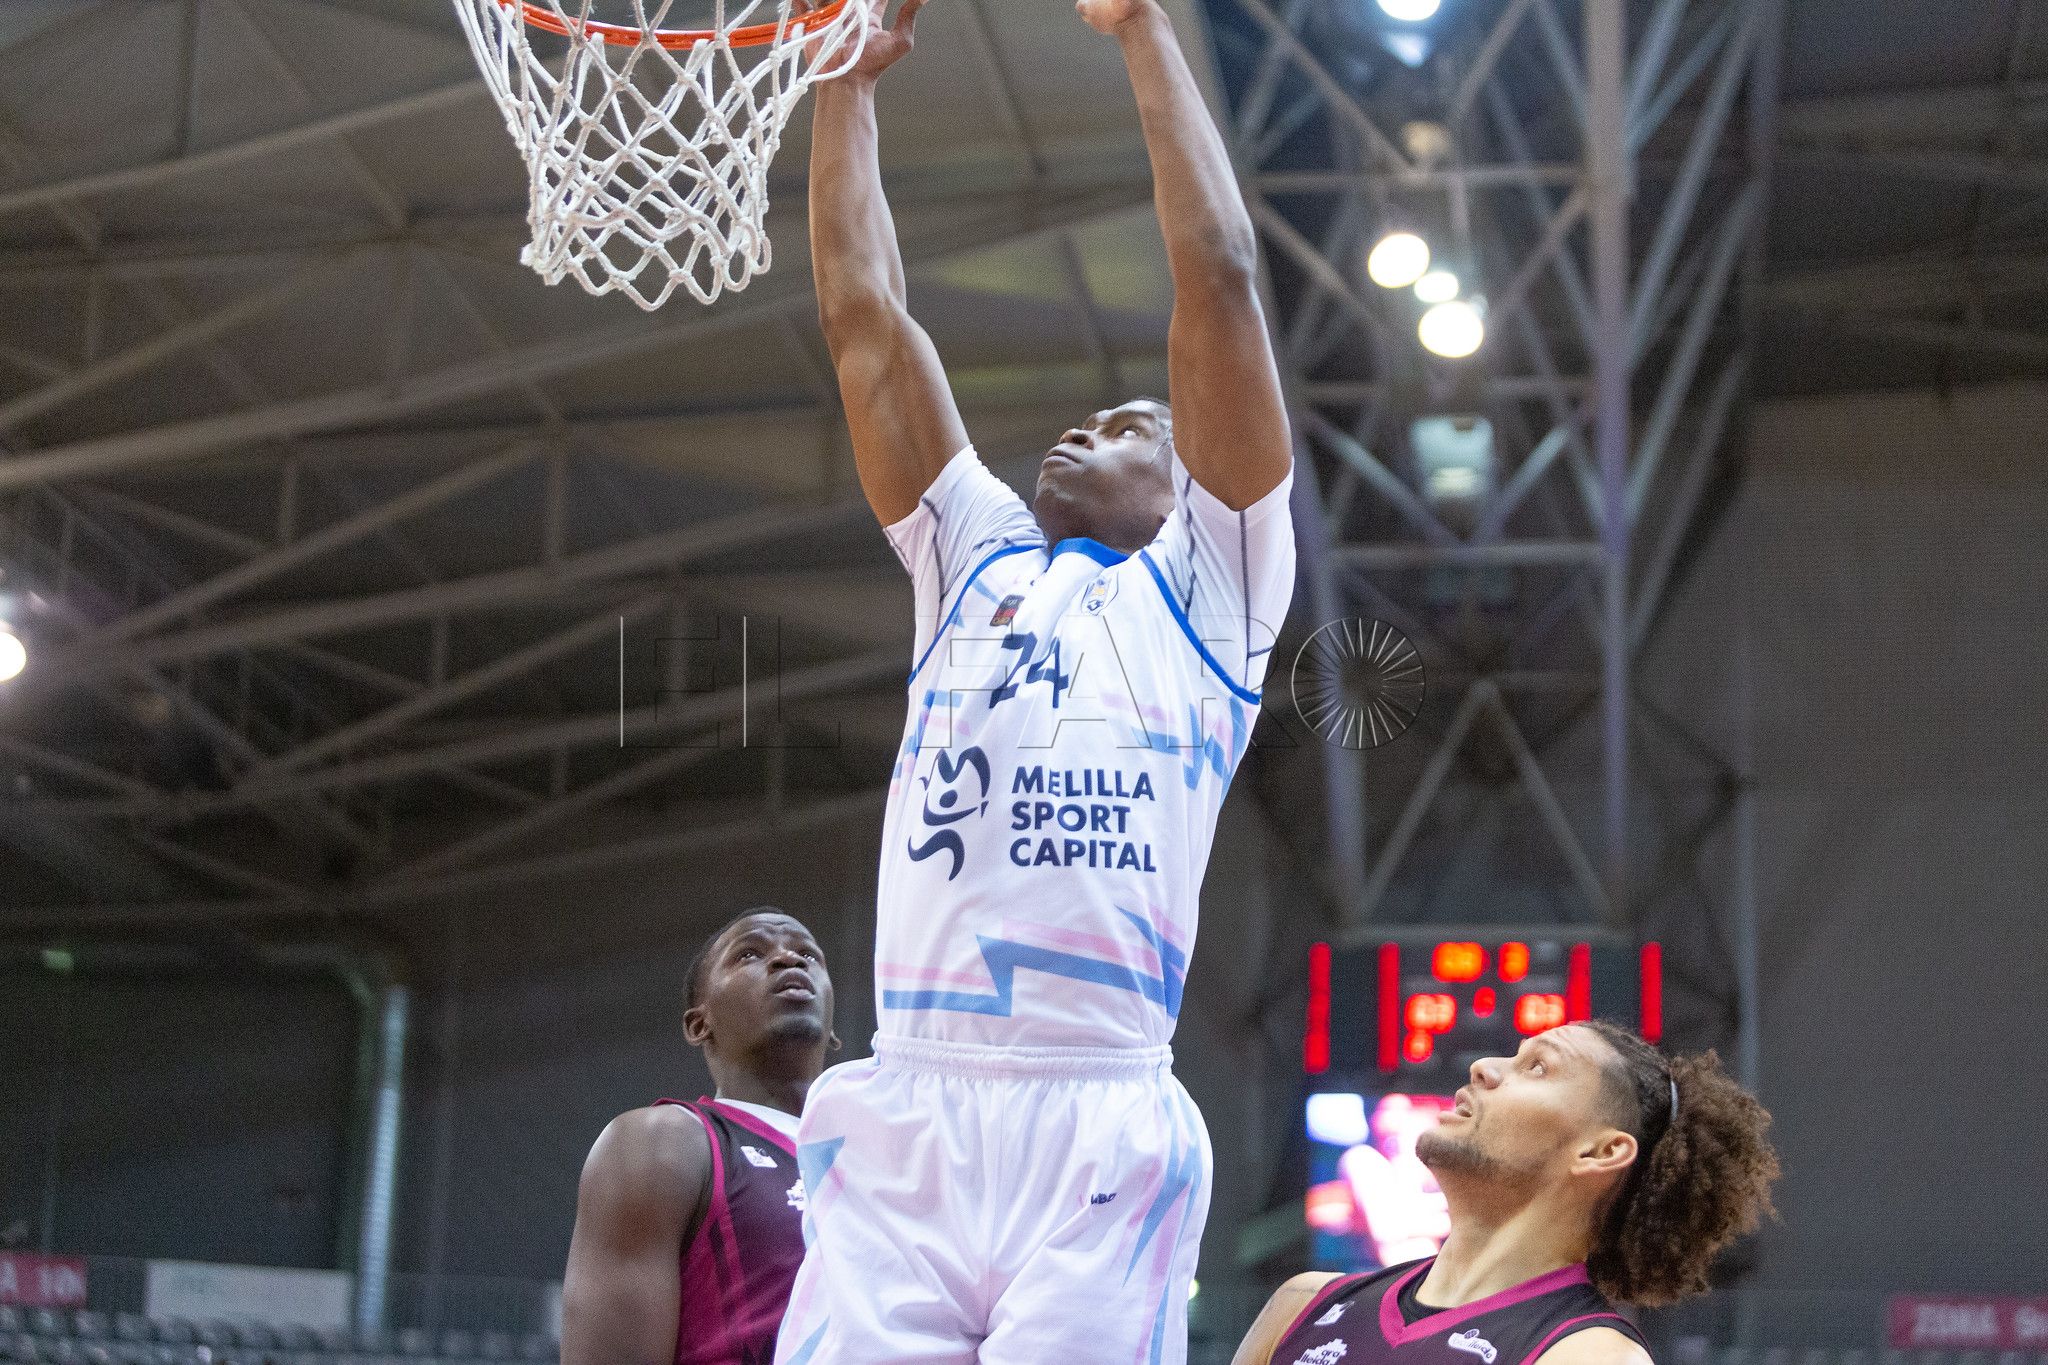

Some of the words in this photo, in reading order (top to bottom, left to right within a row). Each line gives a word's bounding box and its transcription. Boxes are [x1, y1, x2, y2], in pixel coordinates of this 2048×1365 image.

[1011, 765, 1156, 801] MELILLA
[1011, 800, 1131, 834] SPORT
[1009, 837, 1157, 873] CAPITAL
